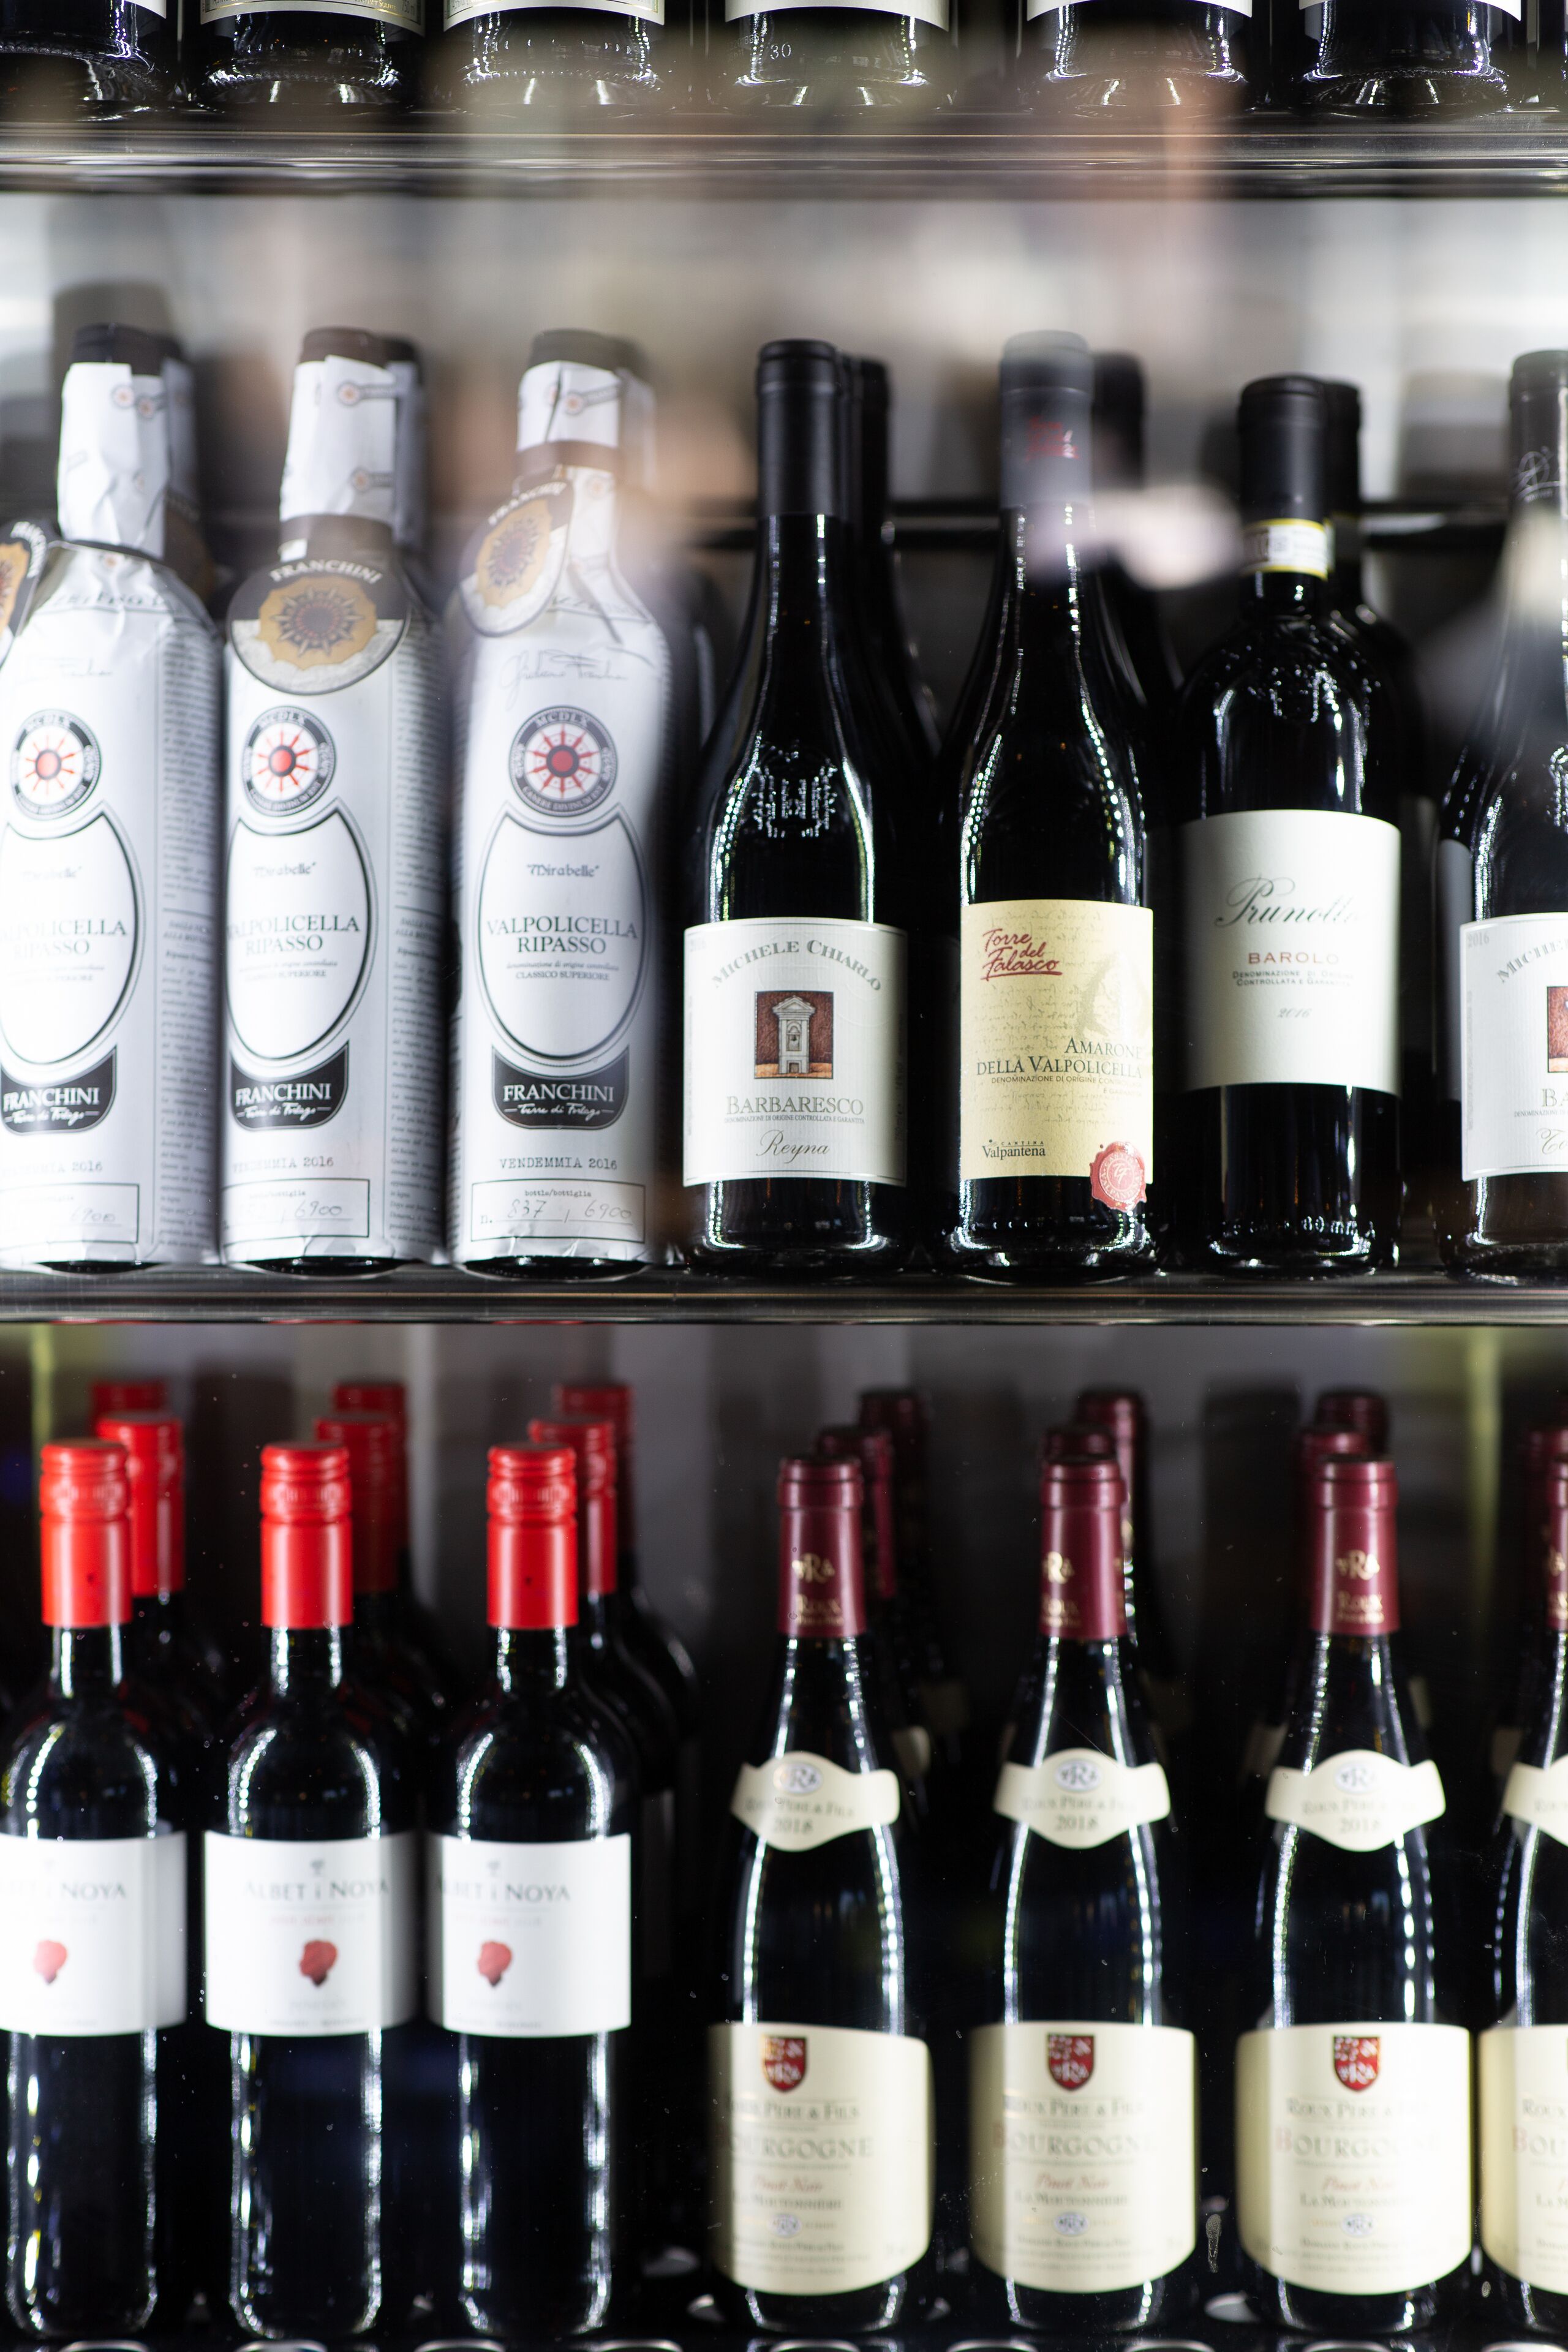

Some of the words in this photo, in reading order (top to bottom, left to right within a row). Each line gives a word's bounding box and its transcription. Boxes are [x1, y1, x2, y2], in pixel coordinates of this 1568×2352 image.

[770, 41, 791, 59] 30
[271, 558, 383, 584] FRANCHINI
[486, 916, 638, 940] VALPOLICELLA
[245, 934, 324, 957] RIPASSO
[518, 936, 607, 954] RIPASSO
[982, 928, 1033, 952] Torre
[1019, 941, 1047, 958] del
[1248, 952, 1340, 965] BAROLO
[711, 940, 799, 989] MICHELE
[807, 939, 881, 991] CHIARLO
[982, 946, 1060, 981] Falasco
[1232, 969, 1300, 979] DENOMINAZIONE
[1237, 978, 1295, 987] CONTROLLATA
[1277, 1007, 1313, 1019] 2016
[1064, 1036, 1142, 1060] AMARONE
[976, 1057, 1025, 1077] DELLA
[1027, 1055, 1142, 1079] VALPOLICELLA
[3, 1087, 101, 1113] FRANCHINI
[235, 1082, 332, 1108] FRANCHINI
[503, 1084, 615, 1102] FRANCHINI
[726, 1096, 864, 1115] BARBARESCO
[795, 1114, 833, 1123] CONTROLLATA
[756, 1129, 830, 1164] Reyna
[981, 1143, 1046, 1160] Valpantena
[72, 1159, 104, 1174] 2016
[303, 1155, 336, 1169] 2016
[499, 1157, 583, 1169] VENDEMMIA
[589, 1157, 618, 1170] 2016
[295, 1200, 344, 1218] 6900
[504, 1881, 571, 1904] NOYA
